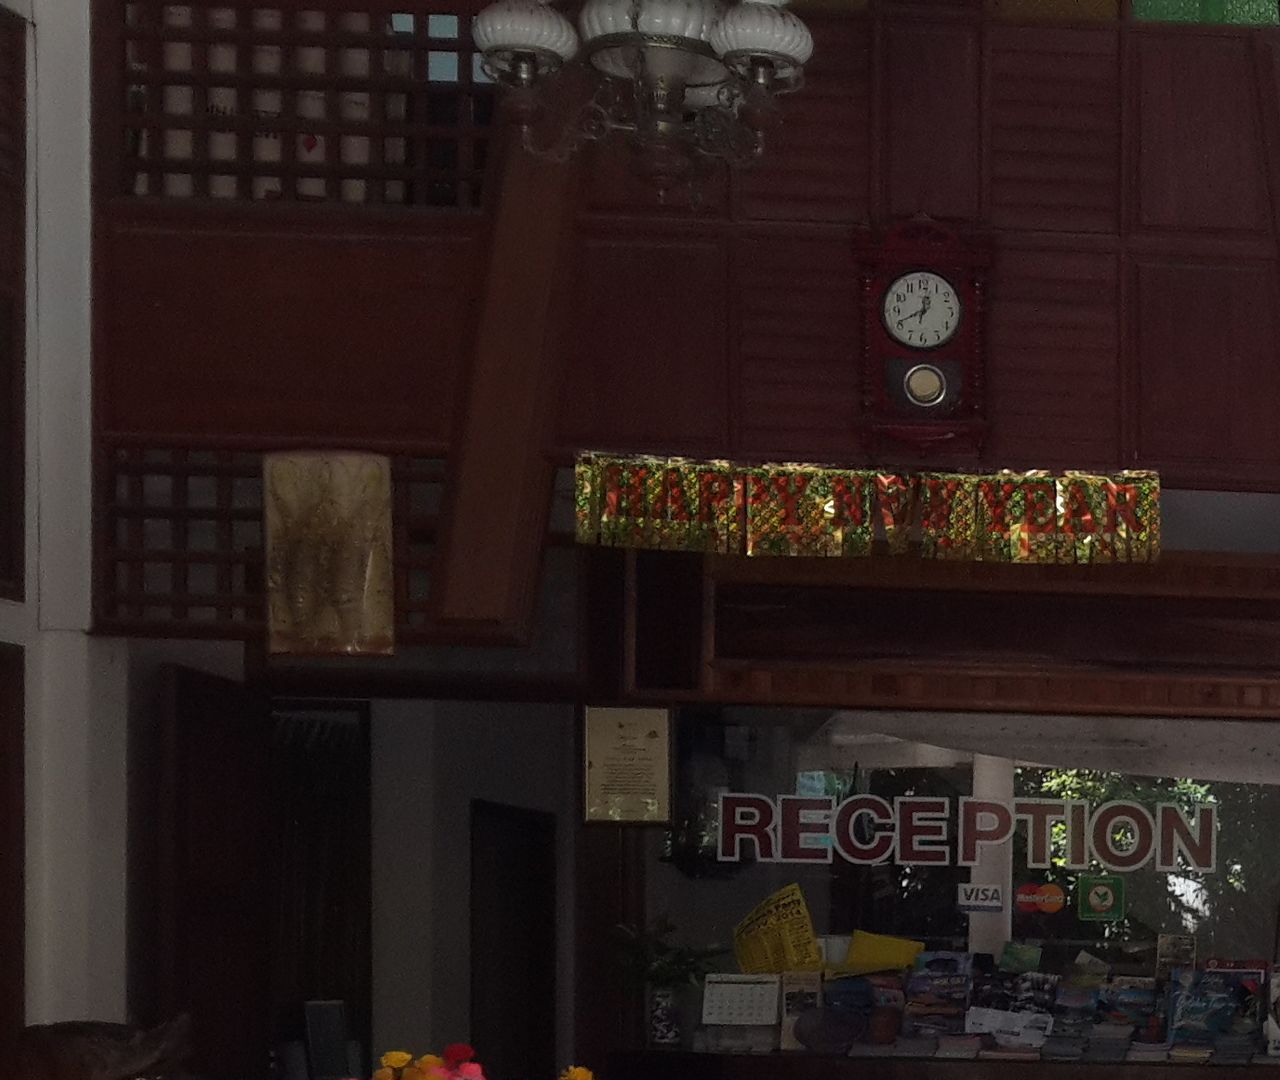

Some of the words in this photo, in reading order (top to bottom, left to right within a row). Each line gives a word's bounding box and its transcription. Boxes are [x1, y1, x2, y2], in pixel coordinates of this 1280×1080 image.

[605, 463, 808, 527] HAPPY
[978, 481, 1147, 535] YEAR
[716, 792, 1218, 874] RECEPTION
[963, 887, 1001, 901] VISA
